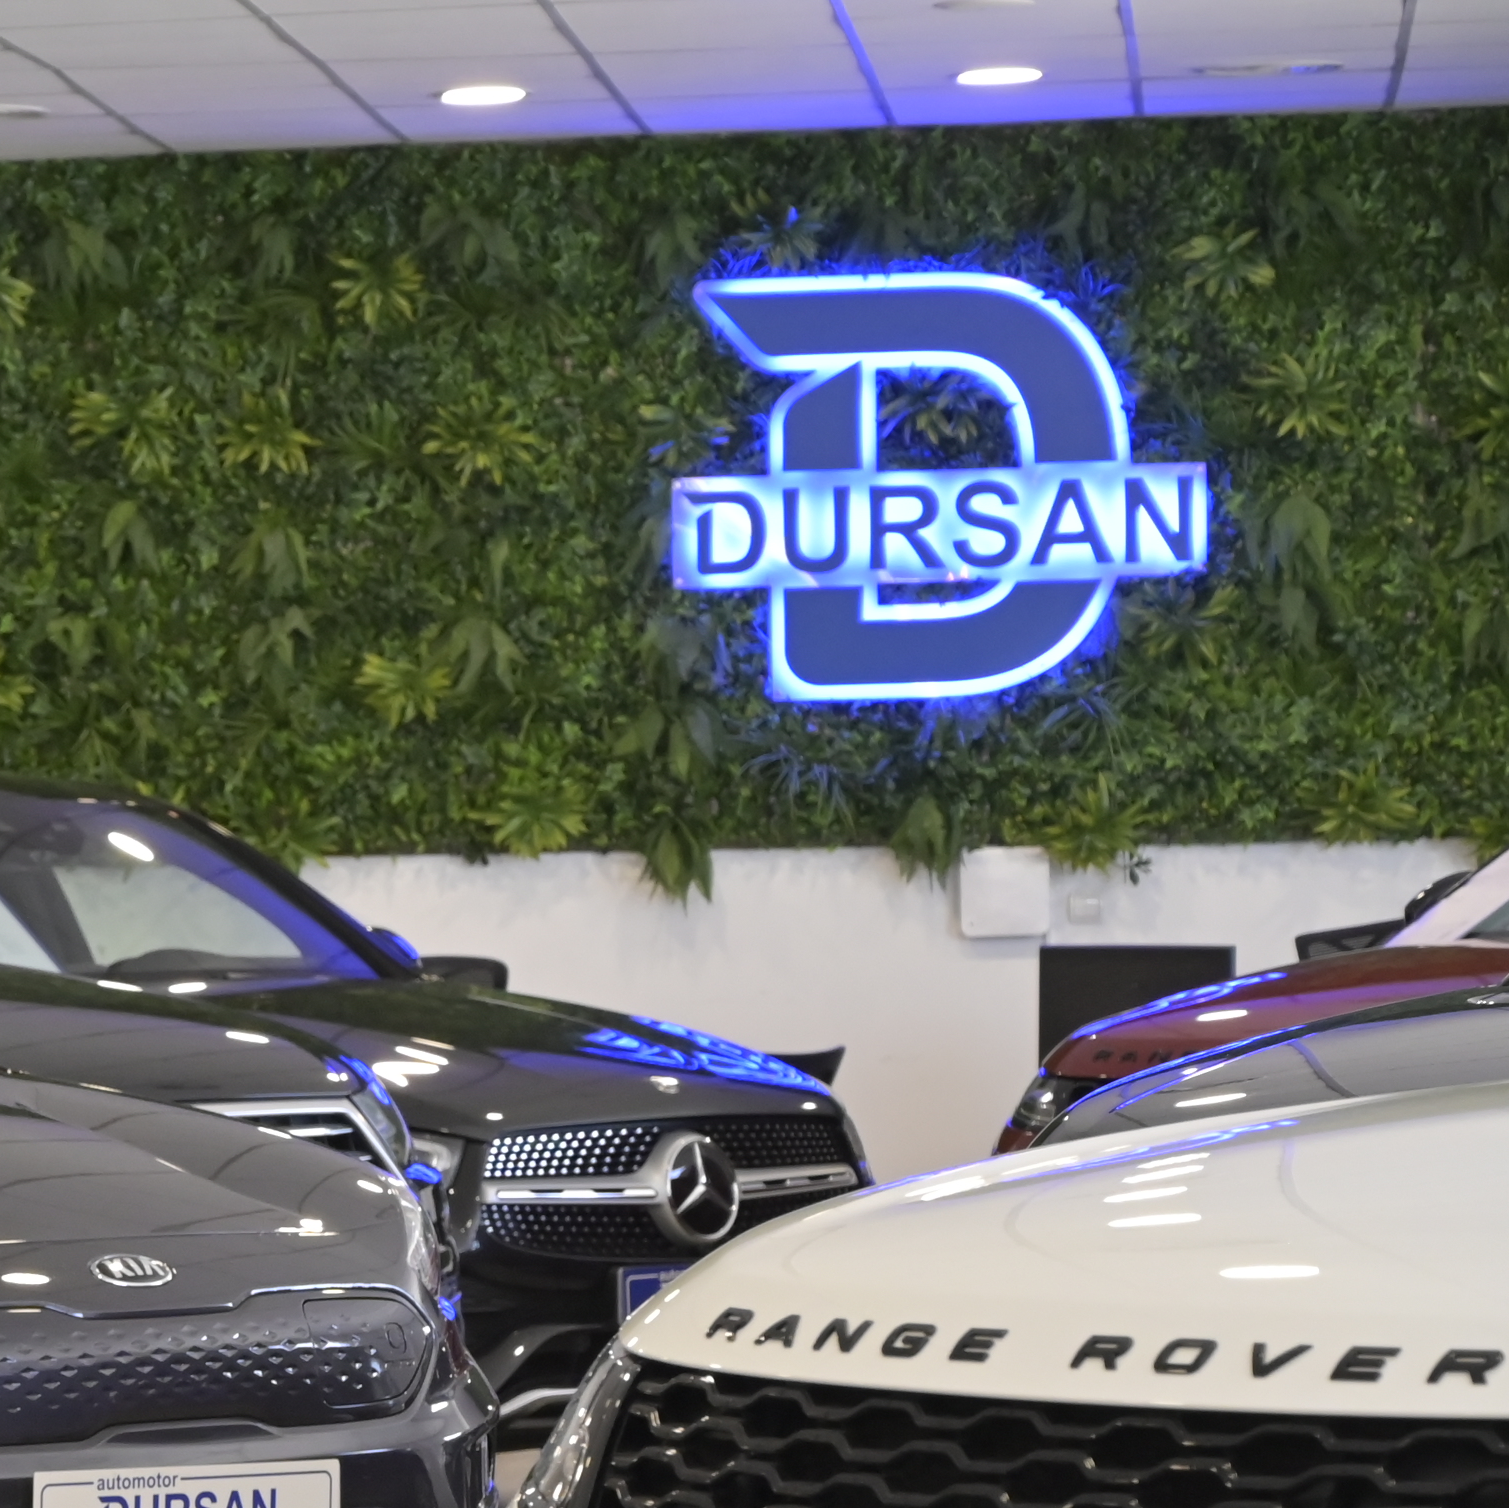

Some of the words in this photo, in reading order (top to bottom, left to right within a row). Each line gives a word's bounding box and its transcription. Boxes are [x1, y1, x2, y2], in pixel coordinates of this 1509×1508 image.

[681, 476, 1195, 575] DURSAN
[101, 1257, 166, 1279] KIA
[706, 1306, 1008, 1362] RANGE
[1070, 1334, 1507, 1385] ROVER
[96, 1473, 179, 1491] automotor
